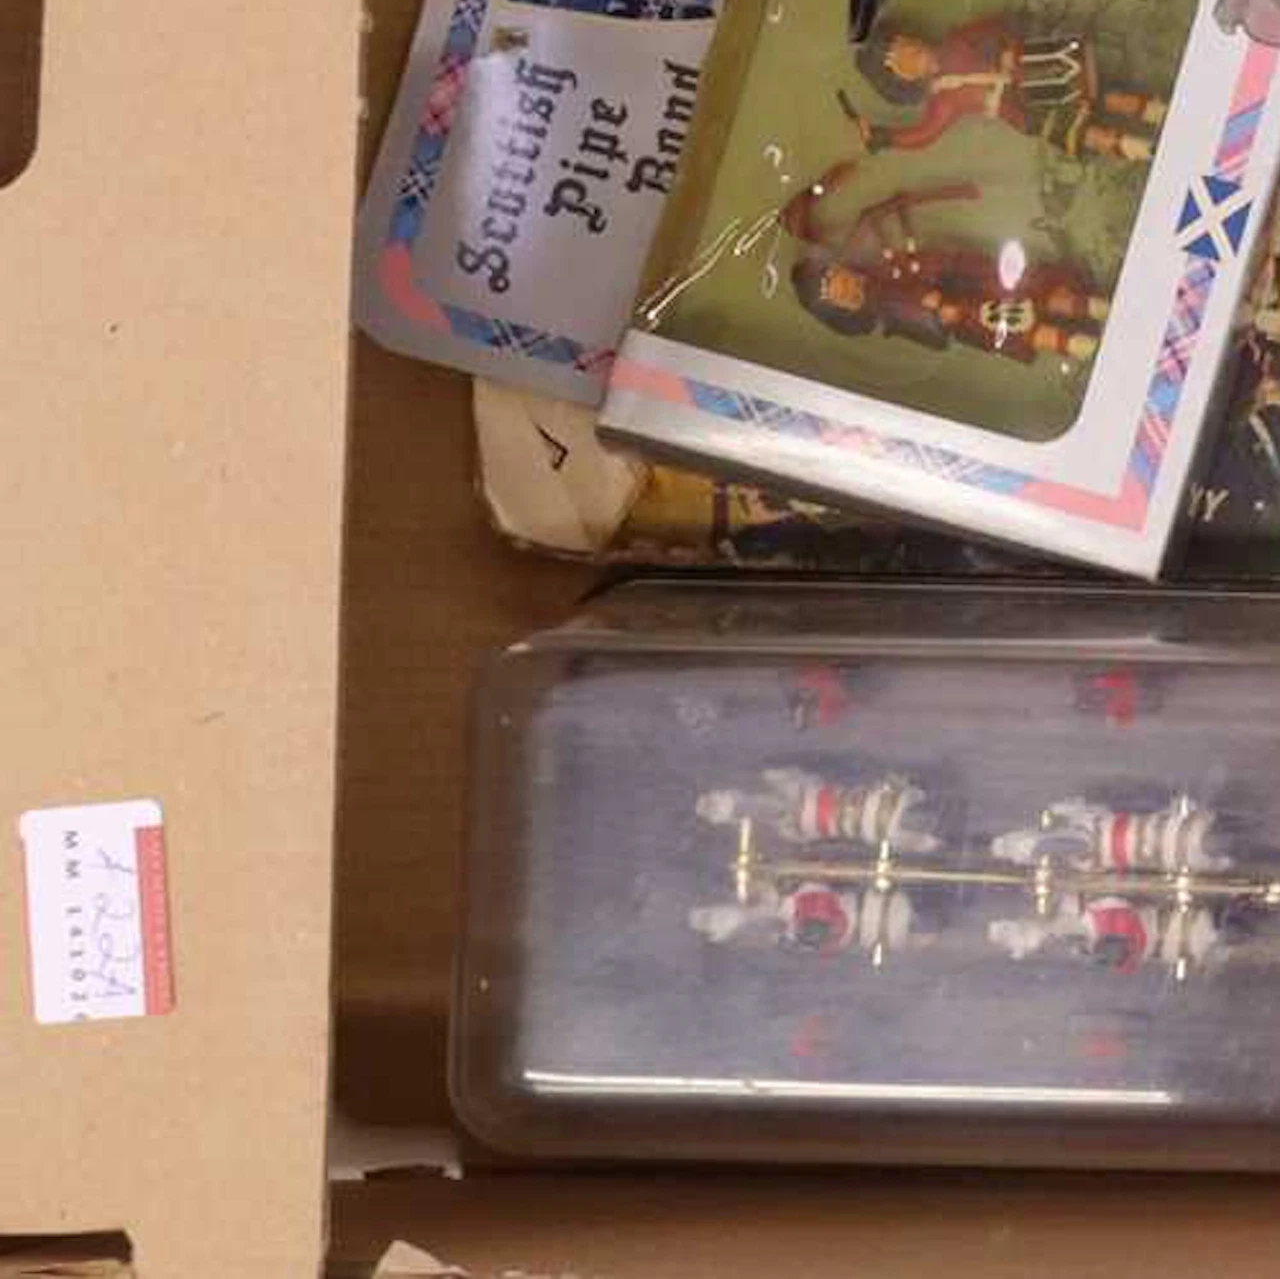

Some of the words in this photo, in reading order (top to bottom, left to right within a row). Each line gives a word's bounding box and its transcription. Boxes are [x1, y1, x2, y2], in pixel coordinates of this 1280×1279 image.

[457, 58, 577, 294] Scottish
[543, 97, 629, 234] Pipe
[625, 59, 702, 194] Band
[64, 830, 82, 879] MM
